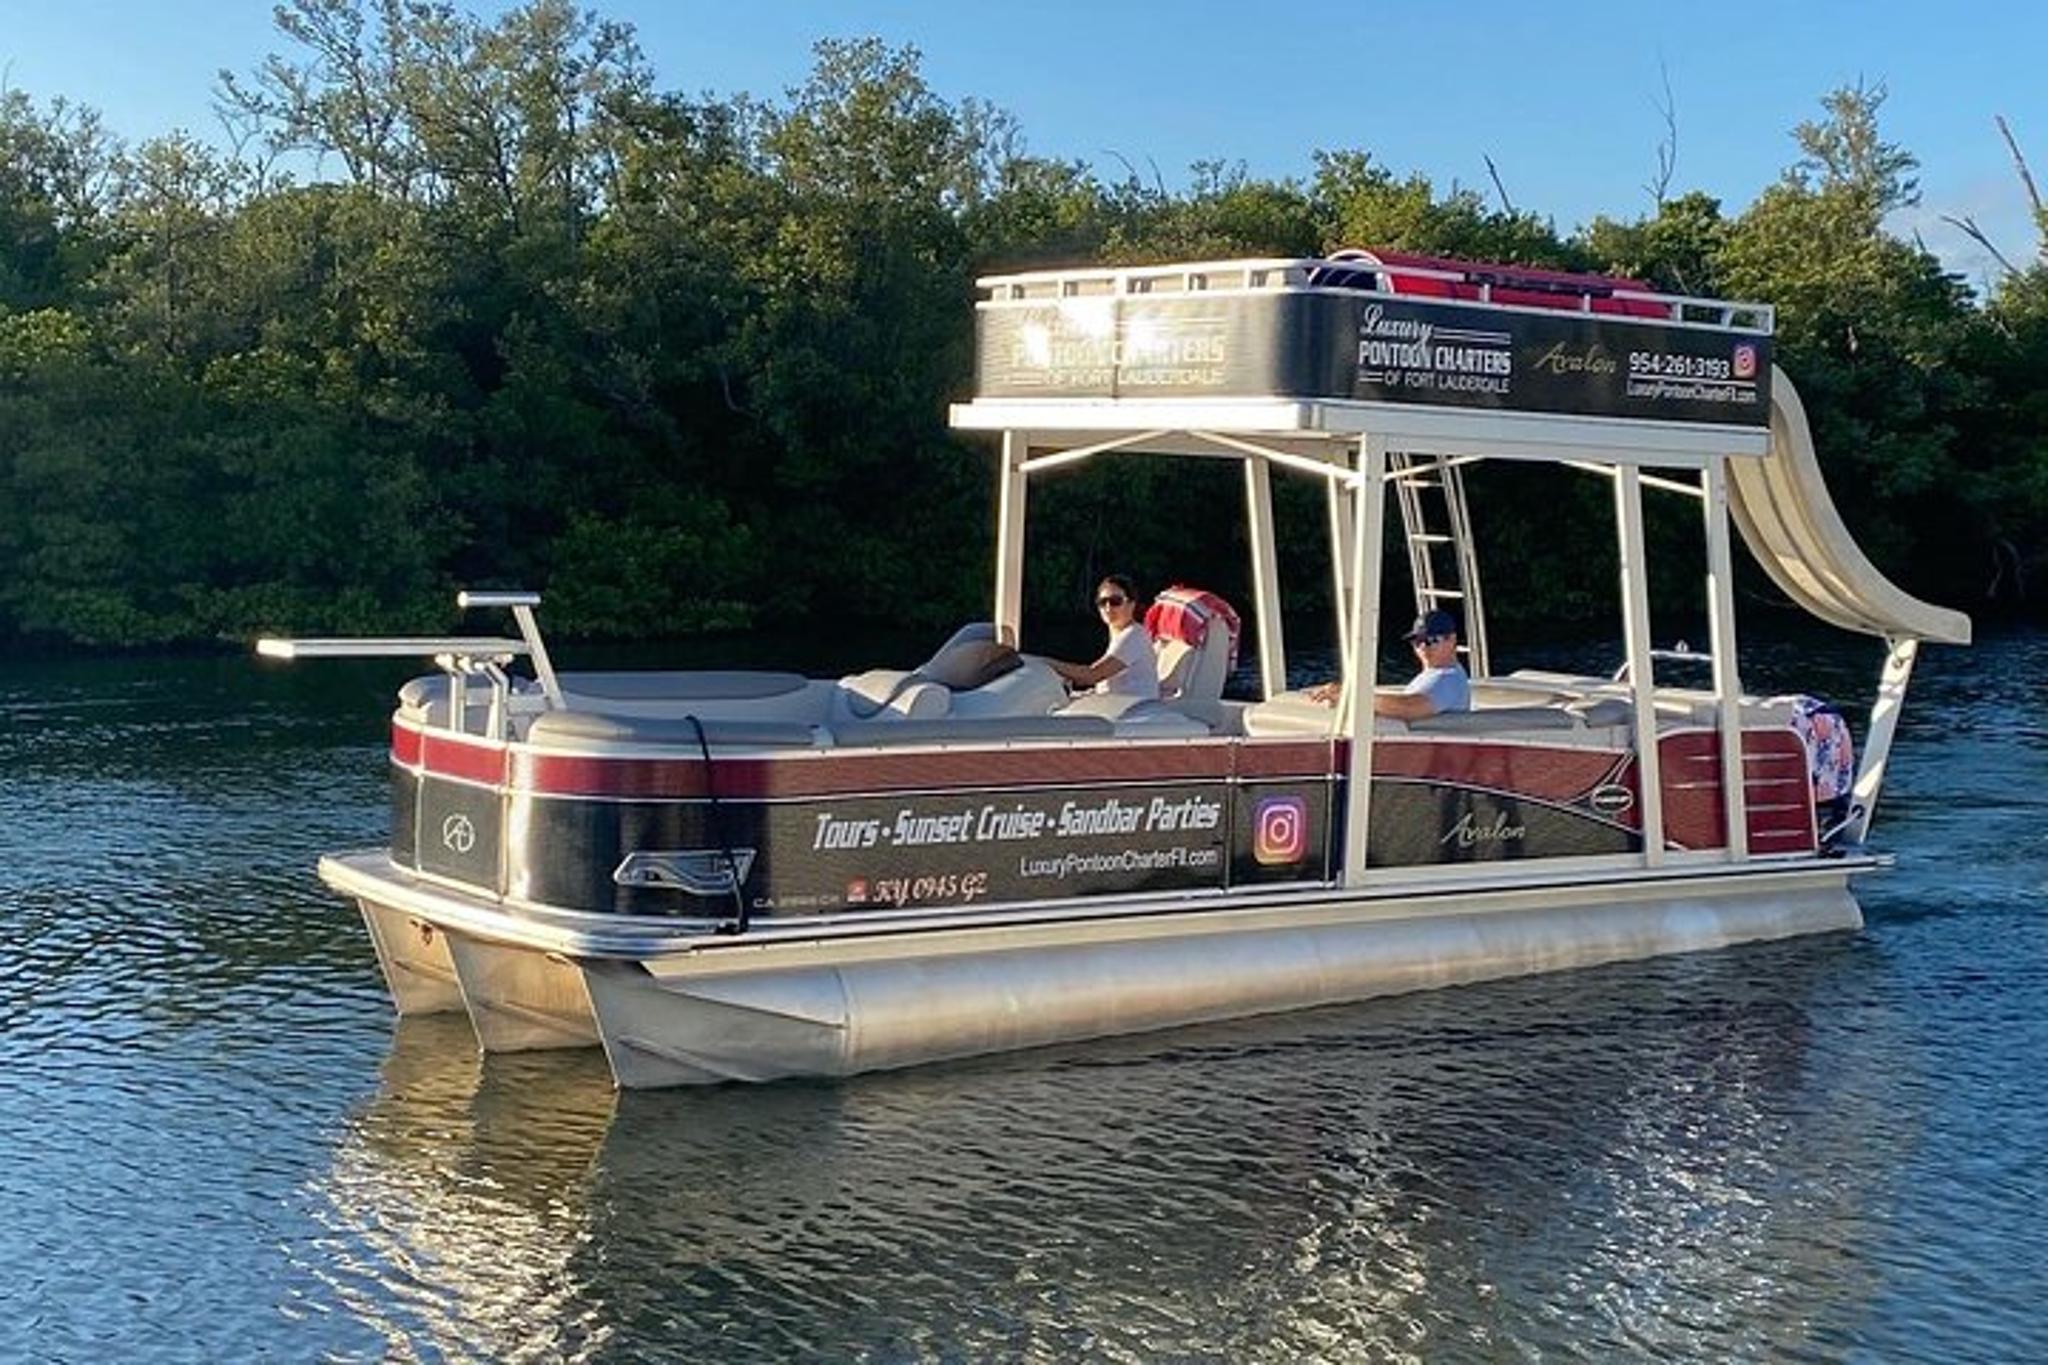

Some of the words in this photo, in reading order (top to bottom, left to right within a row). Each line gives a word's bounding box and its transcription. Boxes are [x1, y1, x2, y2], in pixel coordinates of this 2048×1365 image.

[1360, 304, 1434, 347] Luxury
[1358, 340, 1432, 369] PONTOON
[1435, 346, 1512, 376] CHARTERS
[1532, 341, 1617, 374] Avalon
[1384, 369, 1401, 386] OF
[1404, 371, 1435, 388] FORT
[1438, 374, 1511, 394] LAUDERDALE
[813, 813, 880, 849] Tours
[892, 809, 974, 845] Sunset
[976, 804, 1045, 840] Cruise
[1056, 799, 1144, 836] Sandbar
[1145, 796, 1221, 831] Parties
[1440, 812, 1526, 848] Avalon
